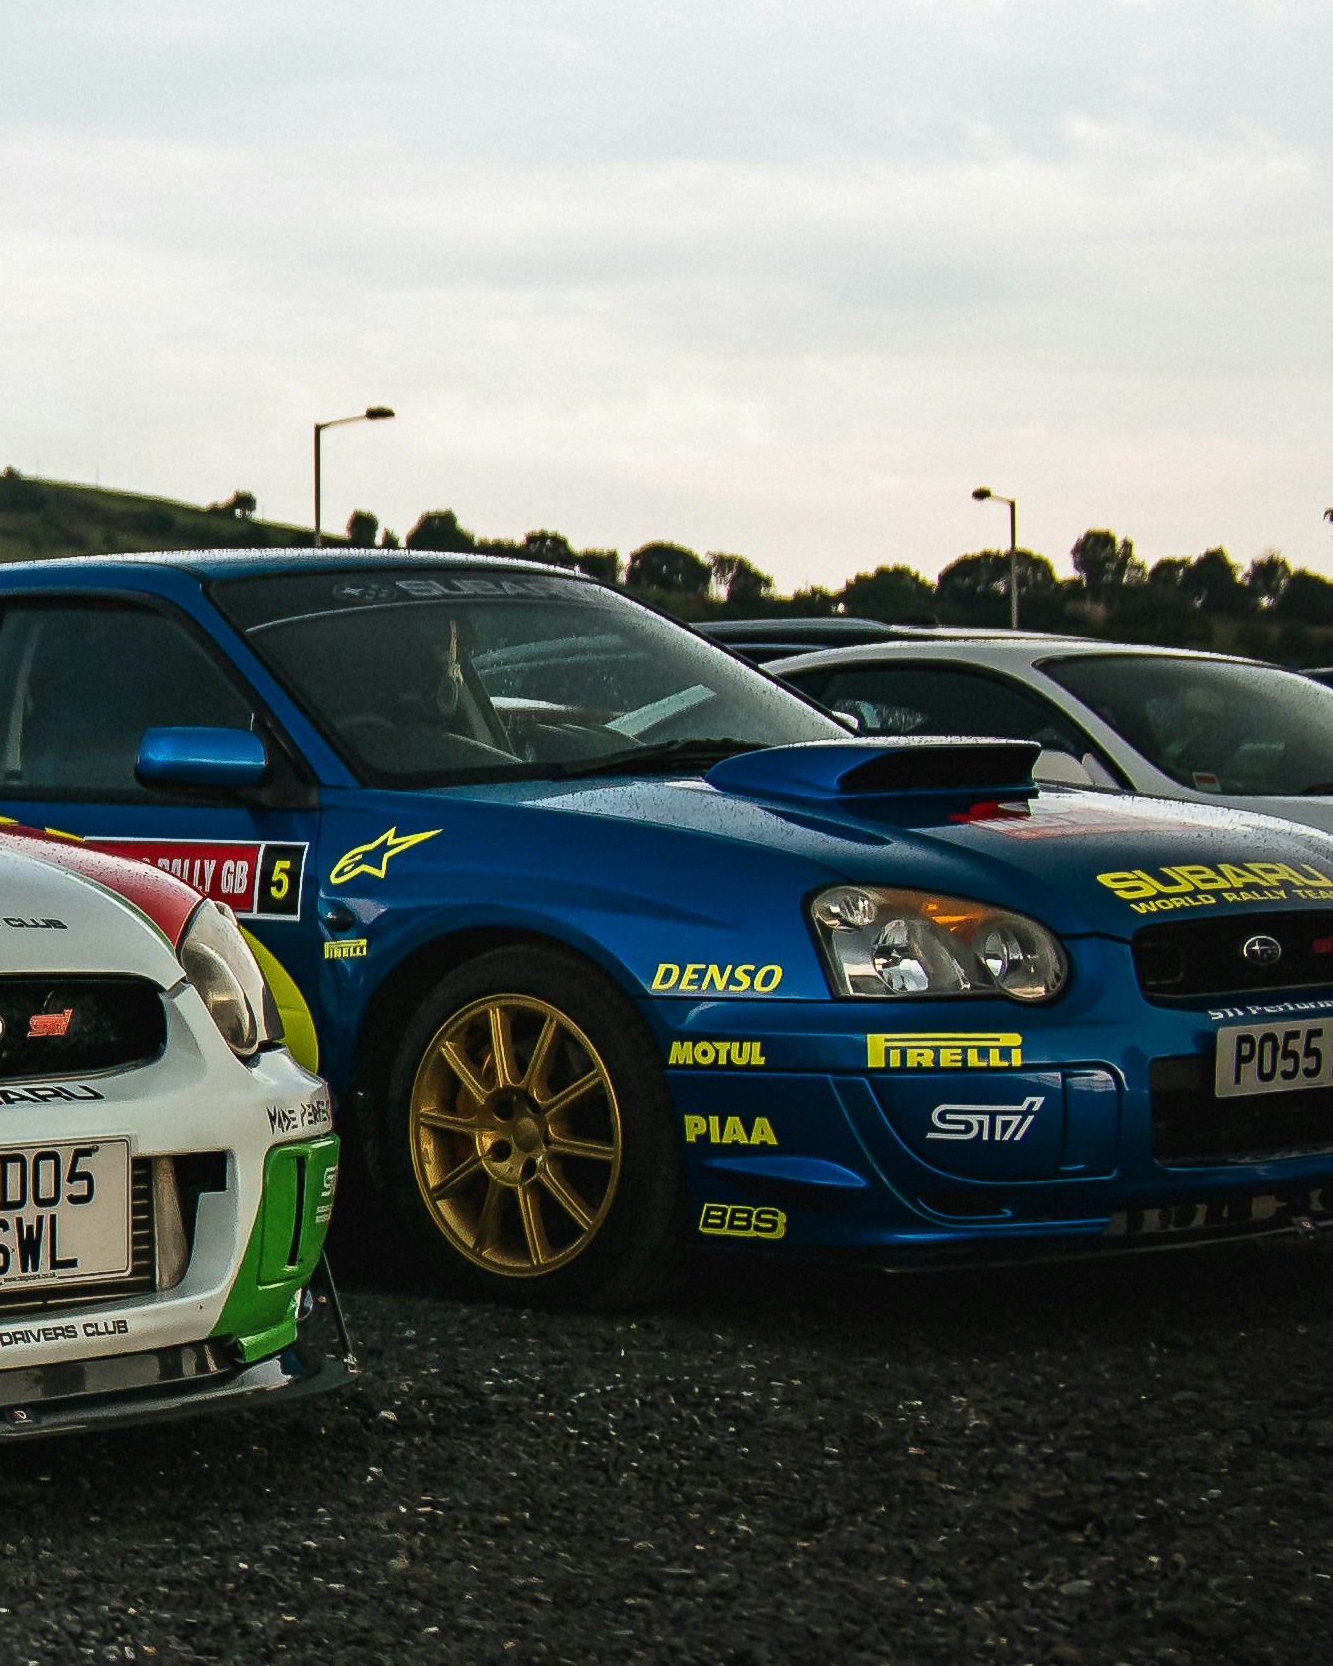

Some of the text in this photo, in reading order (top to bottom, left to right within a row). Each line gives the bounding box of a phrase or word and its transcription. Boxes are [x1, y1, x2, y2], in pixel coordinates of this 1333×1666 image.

[220, 859, 249, 894] GB
[270, 860, 291, 900] 5
[1096, 862, 1333, 900] SUBARU
[1130, 888, 1333, 915] WORLD RALLY TEA
[2, 917, 69, 930] CLUB
[650, 963, 784, 993] DENSO
[668, 1040, 766, 1066] MOTUL
[866, 1032, 1023, 1068] PIRELLI
[684, 1114, 779, 1146] PIAA
[699, 1202, 787, 1240] BBS
[83, 1319, 129, 1338] CLUB
